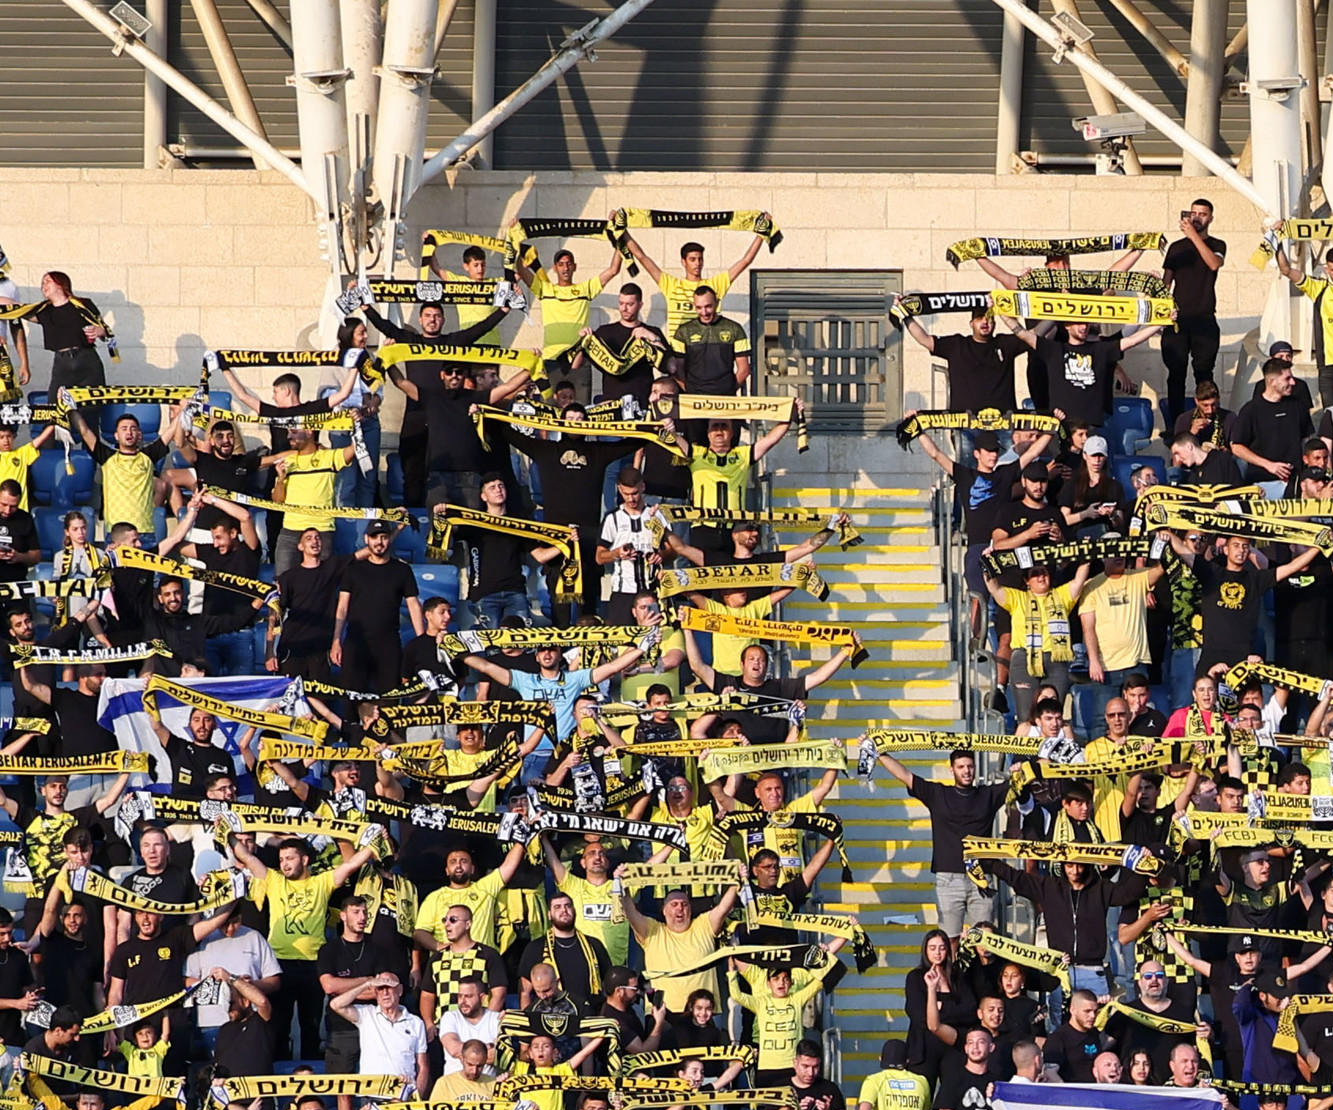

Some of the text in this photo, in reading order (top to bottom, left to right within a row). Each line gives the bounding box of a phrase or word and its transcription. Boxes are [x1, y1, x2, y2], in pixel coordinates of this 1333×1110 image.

[368, 283, 416, 297] ירושלים
[443, 283, 496, 296] JERUSALEM
[1042, 302, 1125, 316] ירושלים
[587, 340, 616, 371] BEITAR
[693, 400, 779, 413] בית"ר ירושלים
[1195, 513, 1285, 535] בית"ר ירושלים
[696, 565, 770, 579] BETAR
[168, 688, 267, 723] בית"ר ירושלים
[391, 717, 441, 729] המדינה
[875, 734, 931, 748] ירושלים
[975, 735, 1041, 750] JERUSALEM
[40, 753, 103, 768] JERUSALEM
[105, 752, 118, 767] FC
[367, 801, 409, 818] ירושלים
[448, 817, 499, 834] JERUSALEM
[539, 811, 558, 830] לא
[562, 813, 579, 826] מי
[583, 815, 625, 831] ישאג
[721, 812, 837, 830] בית"ר ירושלים
[627, 822, 650, 836] אם
[985, 934, 1004, 949] לבד
[1038, 949, 1051, 963] לא
[48, 1060, 151, 1092] ירושלים
[257, 1077, 373, 1095] ירושלים
